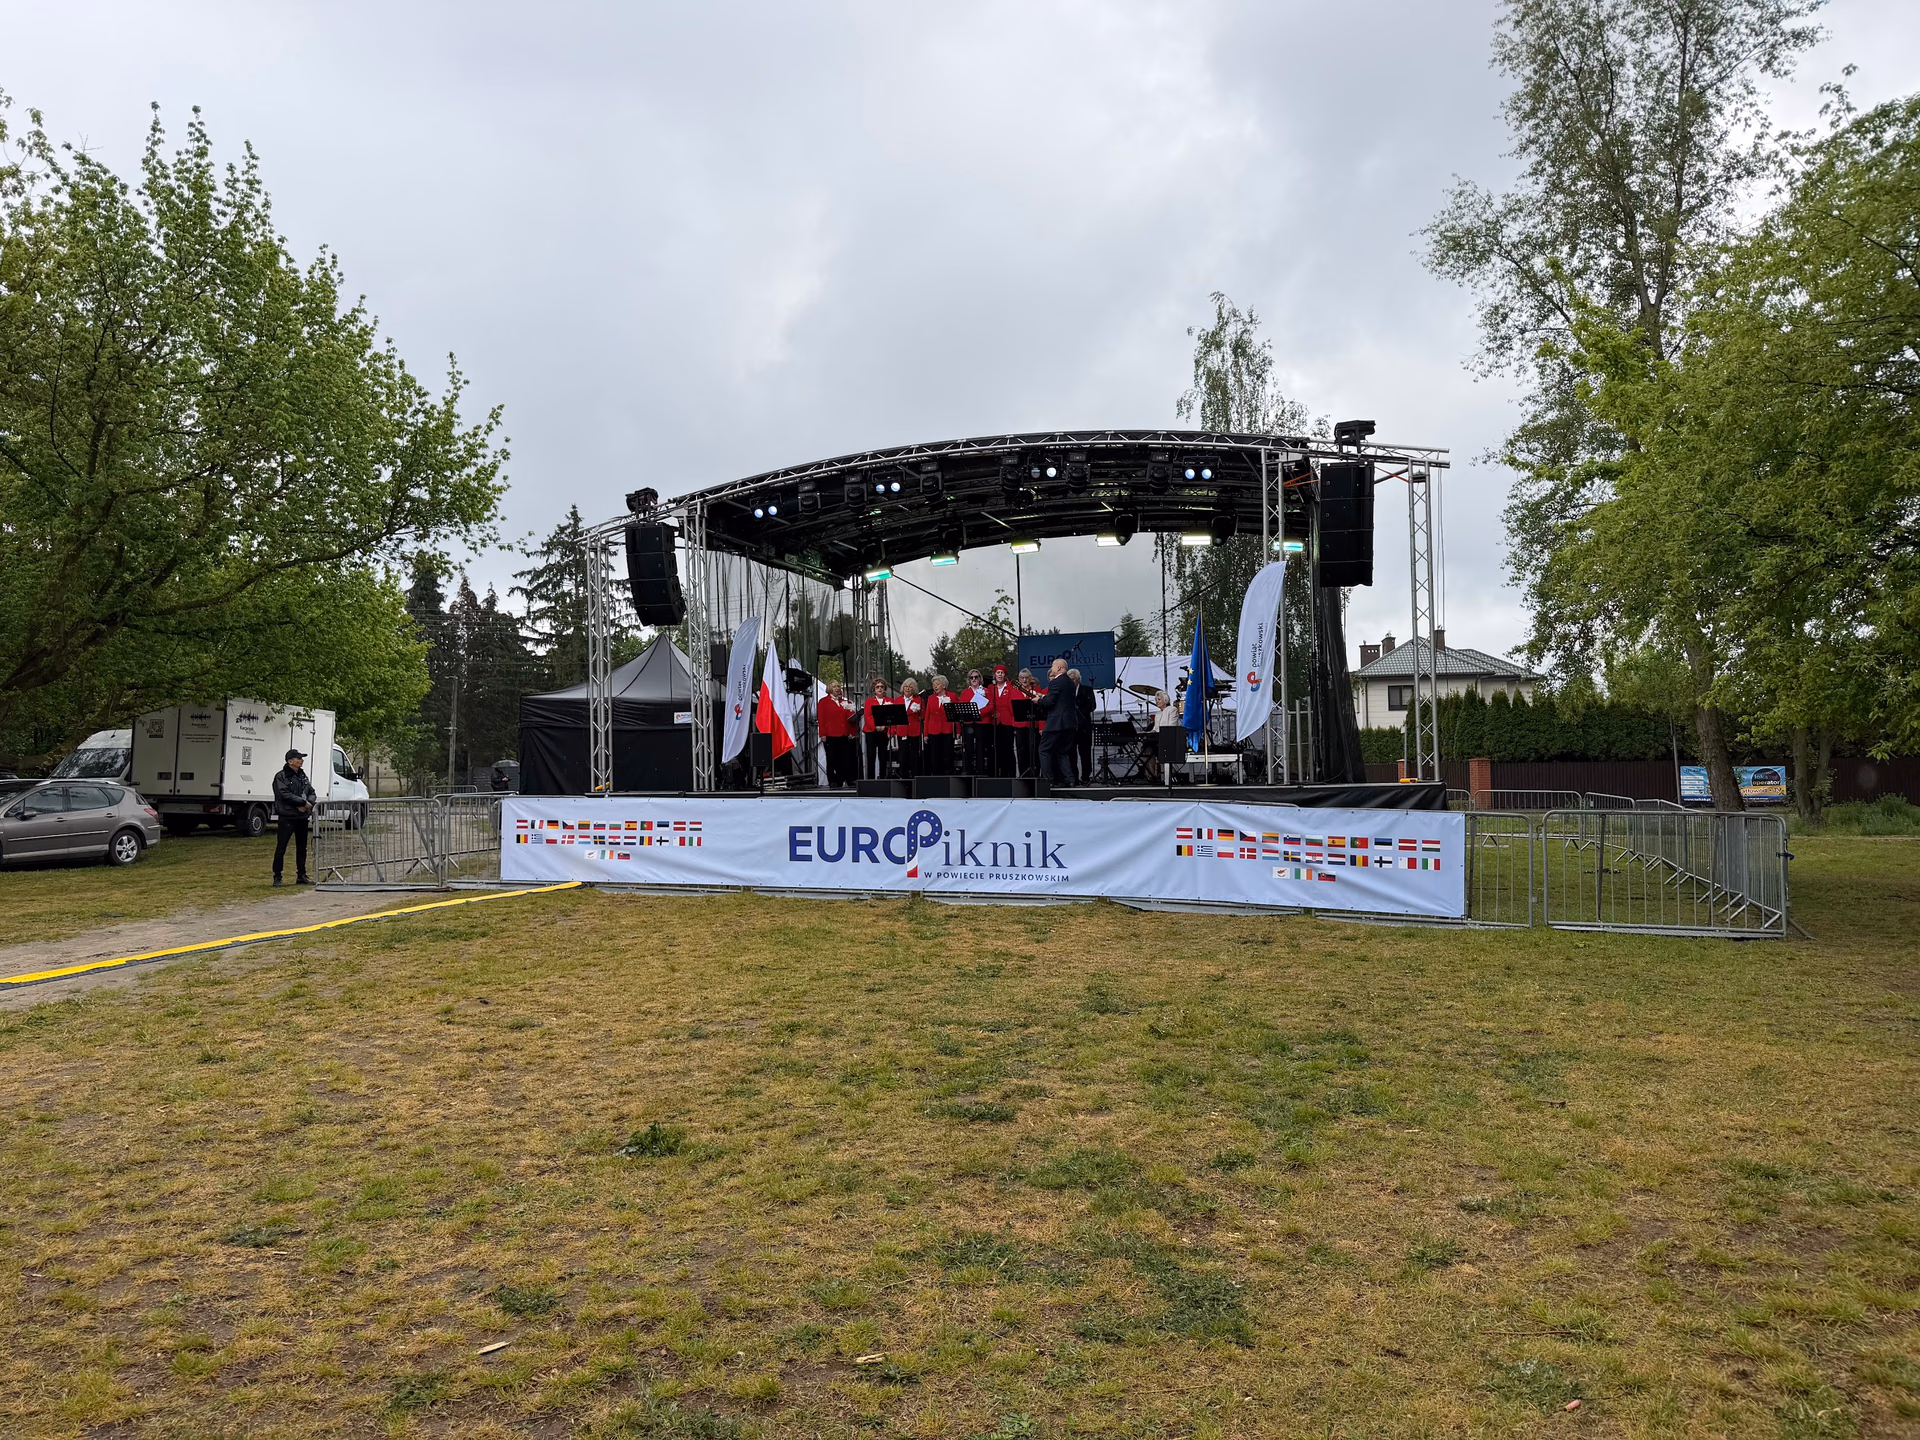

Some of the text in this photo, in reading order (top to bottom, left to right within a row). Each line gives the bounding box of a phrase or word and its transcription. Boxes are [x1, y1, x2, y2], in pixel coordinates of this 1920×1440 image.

[924, 871, 1070, 882] W POWIECIE PRUSZKOWSKIM
